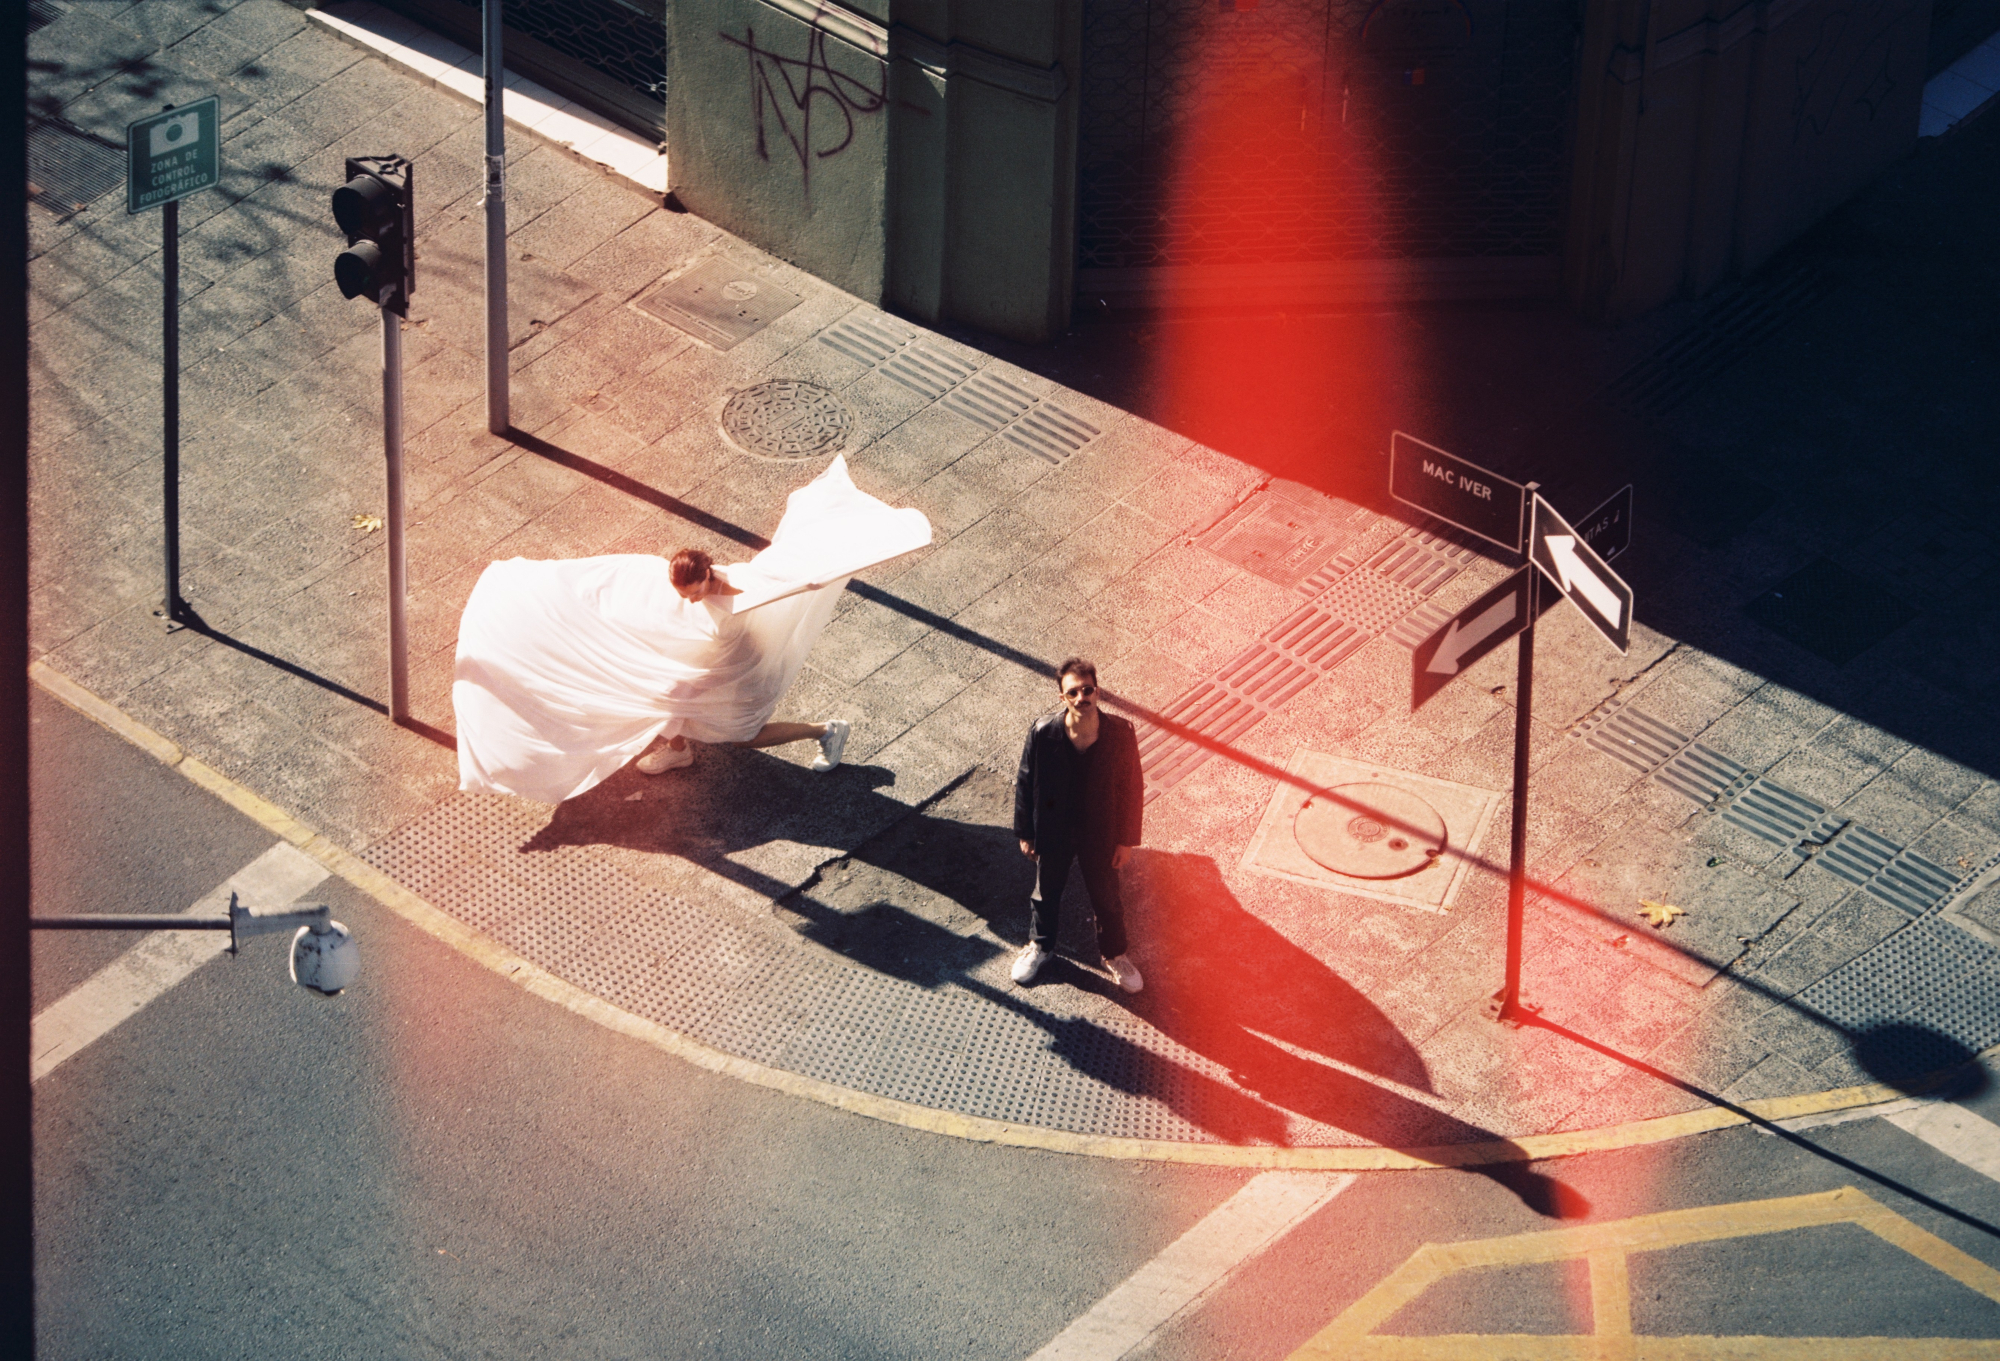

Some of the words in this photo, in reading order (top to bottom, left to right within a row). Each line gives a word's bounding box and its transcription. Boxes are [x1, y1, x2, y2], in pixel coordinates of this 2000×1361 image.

[150, 156, 178, 174] ZONA
[185, 149, 198, 161] DE
[152, 164, 196, 187] CONTROL
[1423, 459, 1455, 485] MAC
[1459, 475, 1492, 501] IVER
